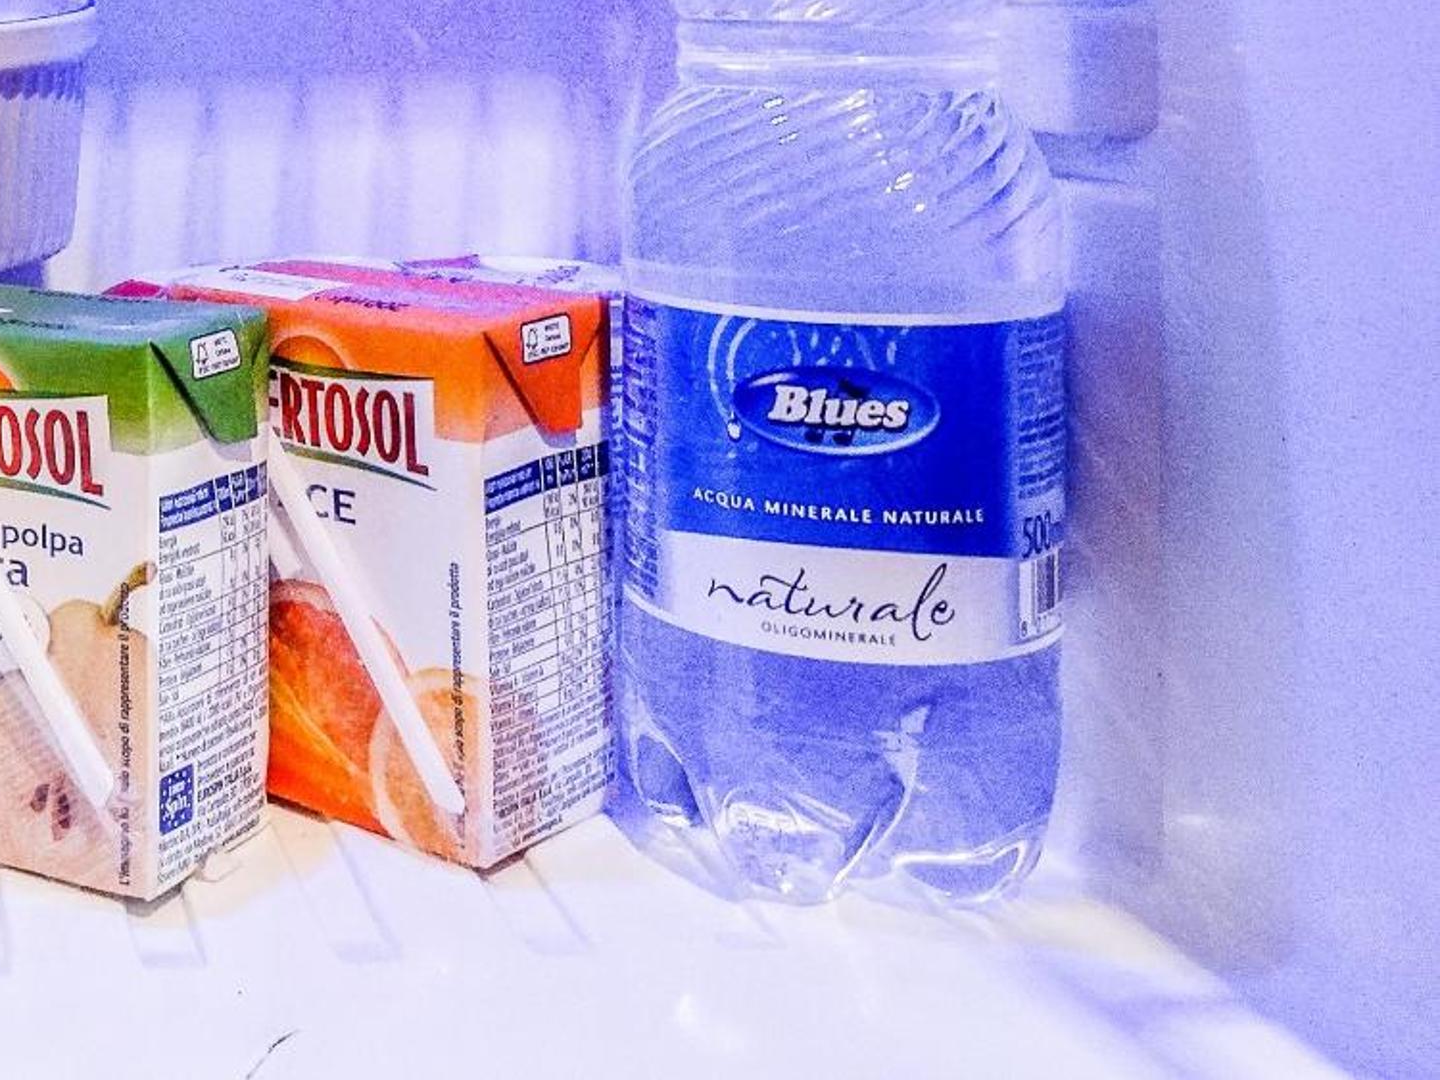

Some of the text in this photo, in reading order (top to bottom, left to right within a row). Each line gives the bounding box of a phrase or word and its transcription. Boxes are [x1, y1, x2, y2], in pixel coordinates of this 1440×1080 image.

[767, 383, 911, 432] Blues
[307, 484, 356, 524] CE
[693, 486, 985, 525] ACQUA MINERALE NATURALE
[1, 523, 84, 558] polpa
[448, 563, 462, 609] prodotto
[707, 563, 956, 642] naturale
[761, 620, 896, 647] OLIGOMINERALE
[450, 621, 464, 693] rappresentare
[119, 644, 132, 720] rappresentare
[452, 695, 463, 706] di
[117, 723, 129, 733] di
